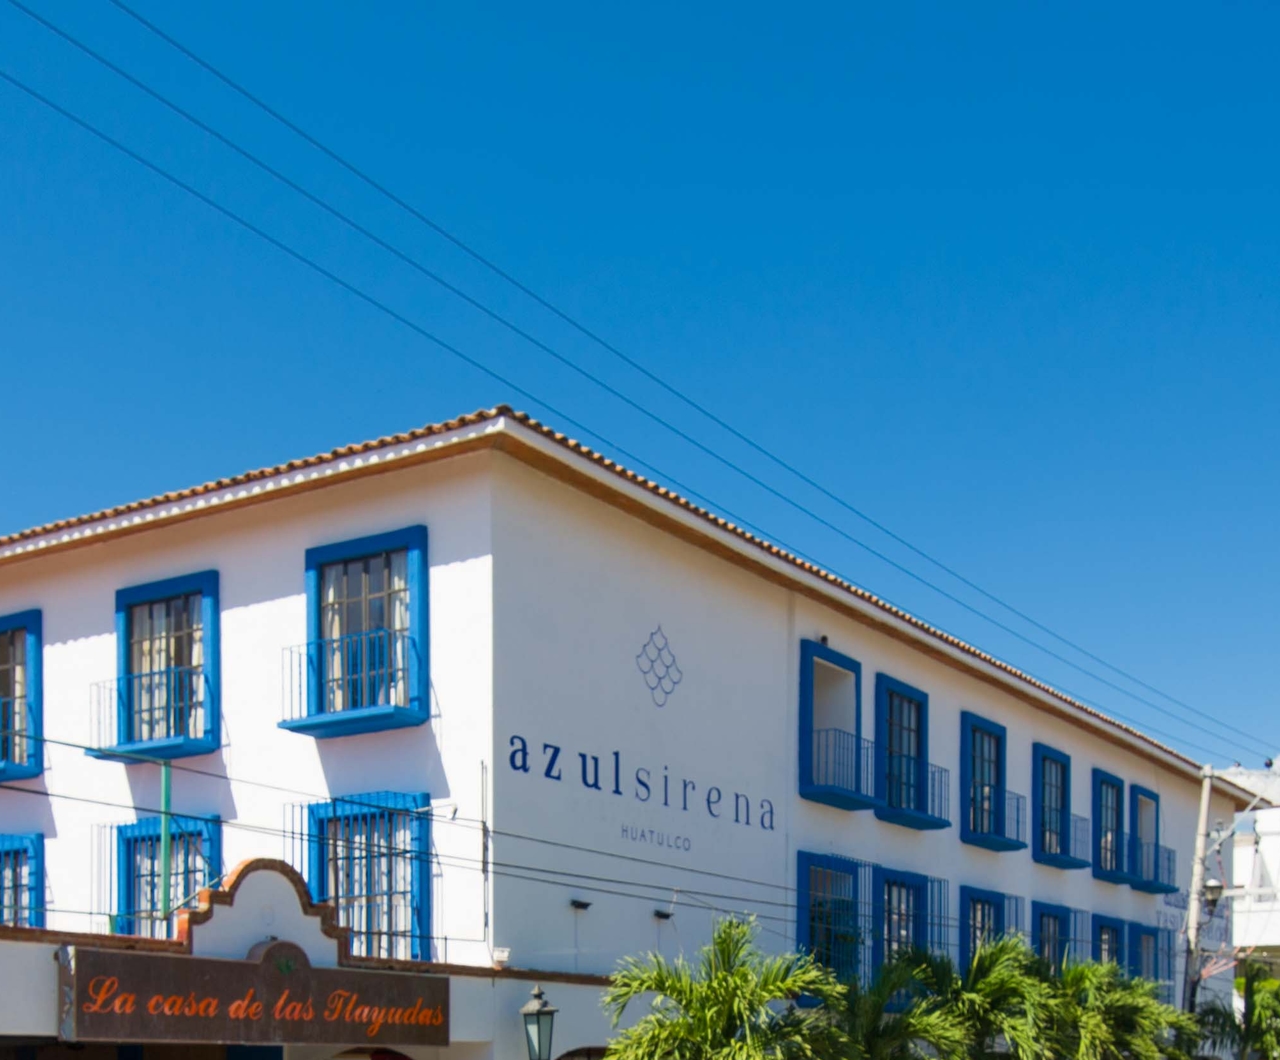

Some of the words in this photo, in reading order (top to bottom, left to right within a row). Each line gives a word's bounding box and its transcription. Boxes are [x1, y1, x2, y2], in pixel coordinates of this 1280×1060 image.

[509, 734, 775, 831] azulsirena
[621, 824, 692, 851] HUATULCO
[81, 975, 136, 1015] La
[146, 994, 219, 1018] casa
[228, 988, 264, 1021] de
[272, 989, 316, 1021] las
[323, 989, 444, 1038] Tlayudas
